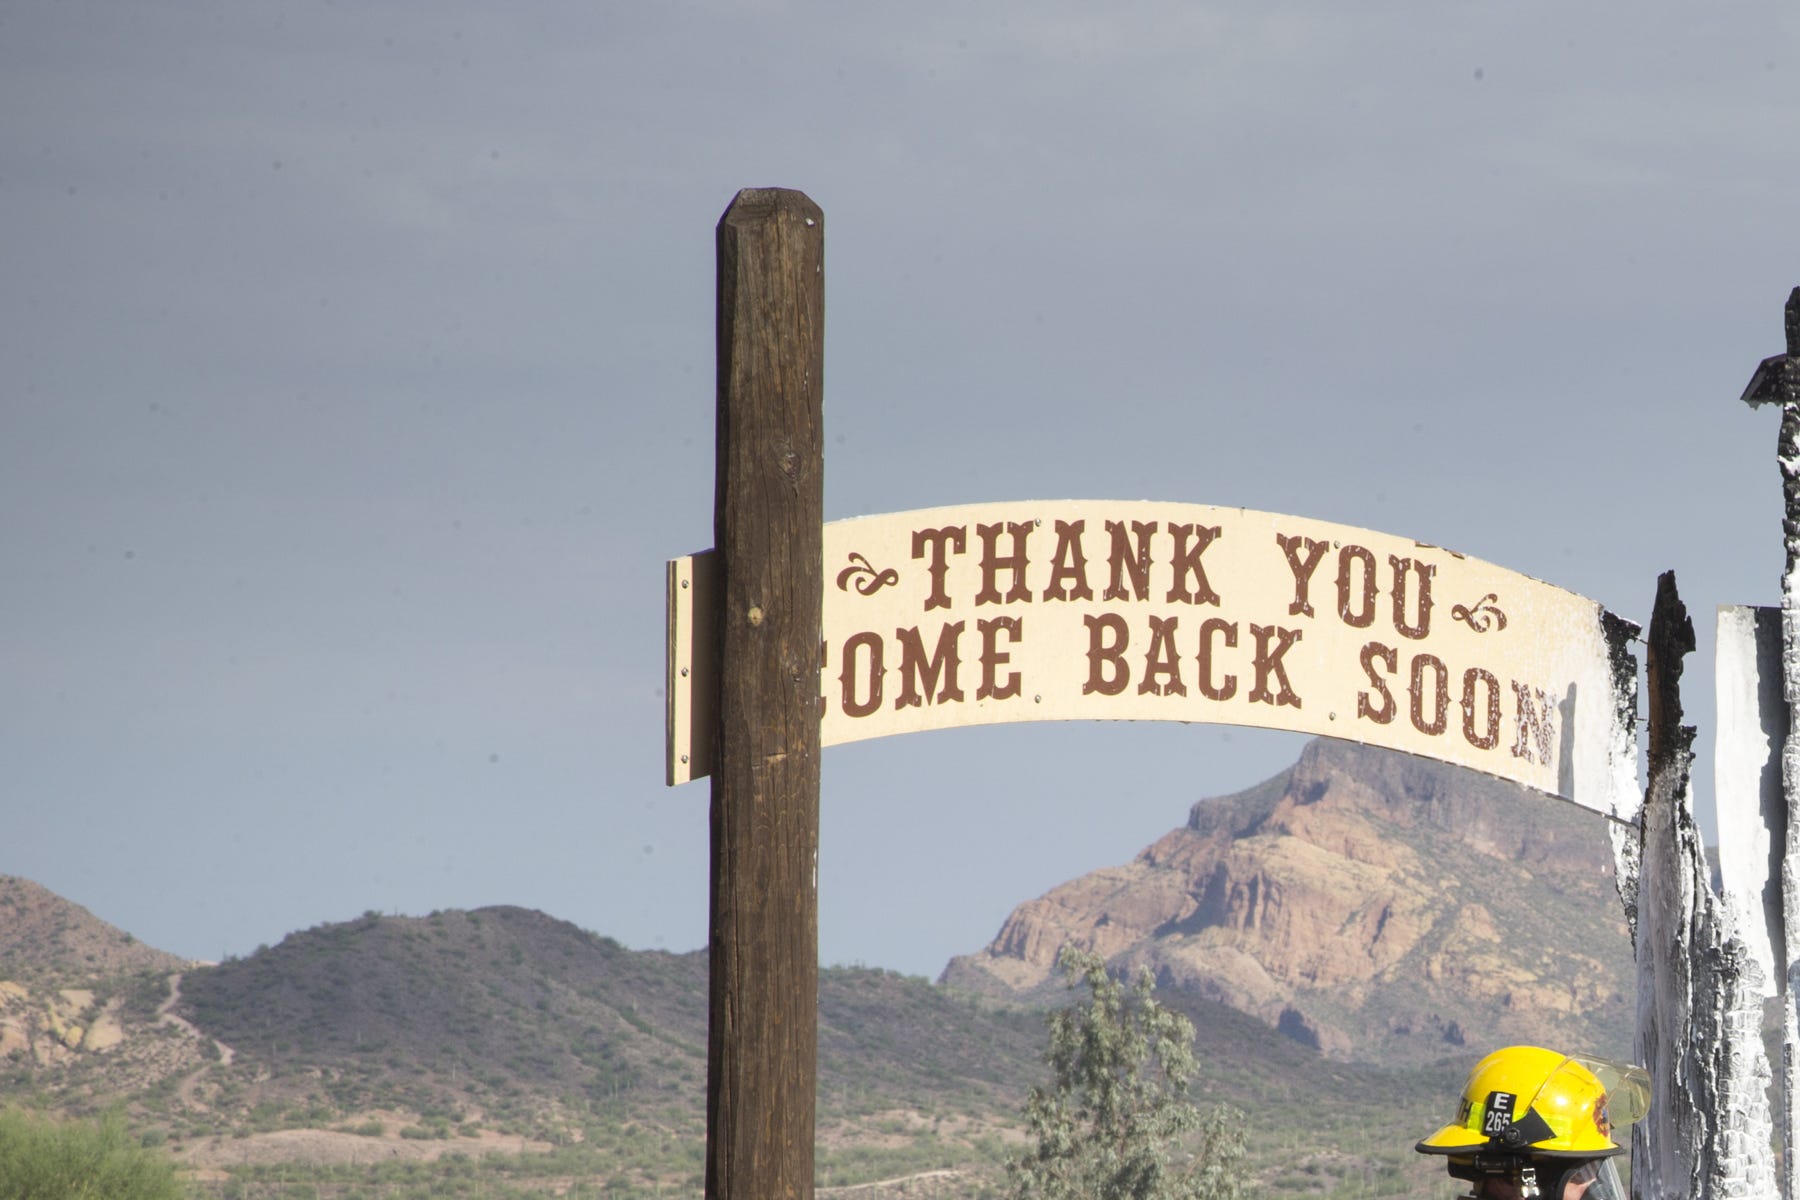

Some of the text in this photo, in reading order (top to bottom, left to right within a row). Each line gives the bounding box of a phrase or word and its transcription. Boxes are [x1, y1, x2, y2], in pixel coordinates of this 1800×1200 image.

[911, 519, 1436, 640] THANK YOU
[820, 613, 1556, 766] OME BACK SOON
[1485, 1110, 1511, 1132] 265
[1493, 1092, 1510, 1110] E
